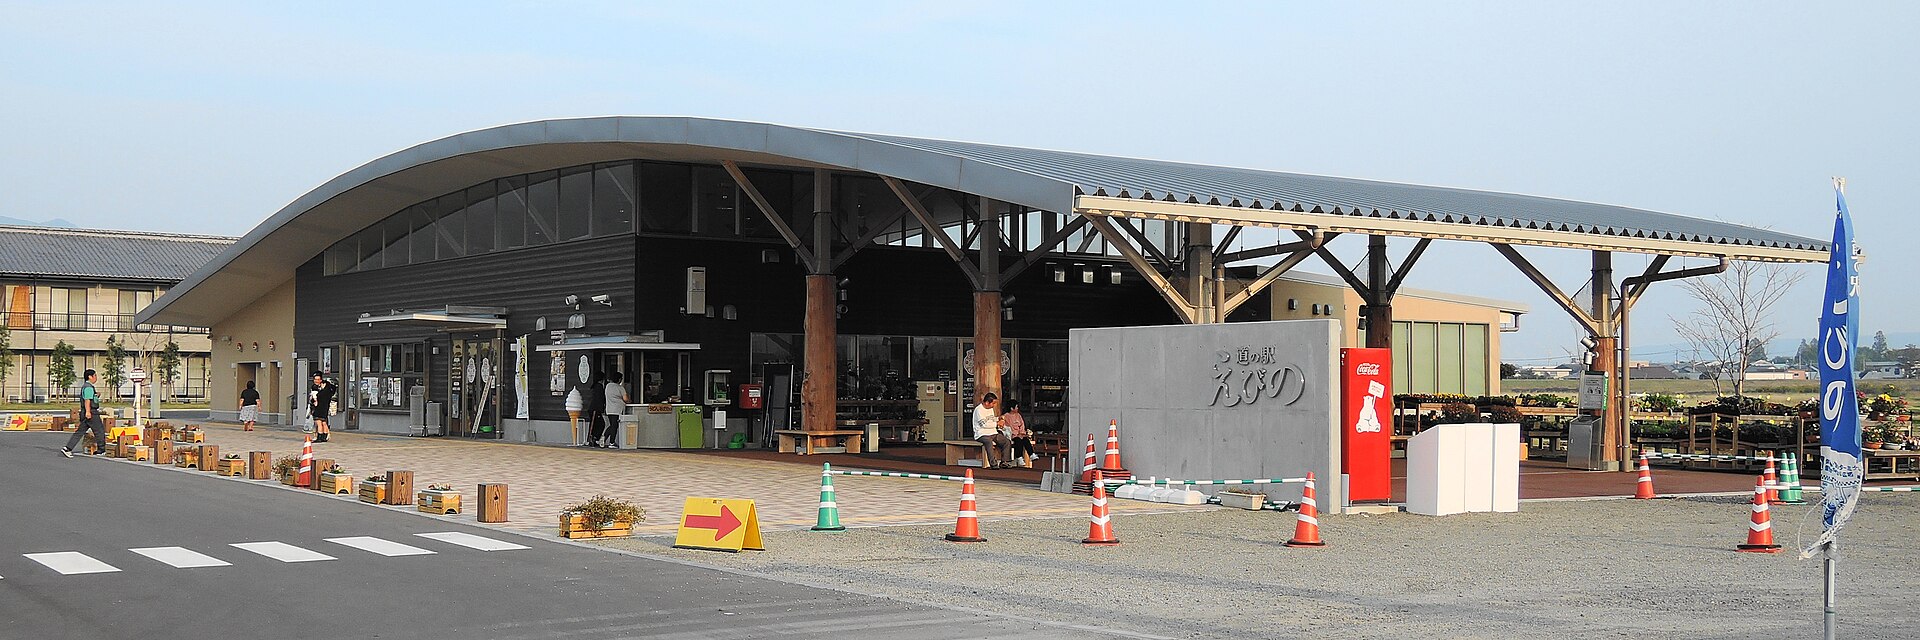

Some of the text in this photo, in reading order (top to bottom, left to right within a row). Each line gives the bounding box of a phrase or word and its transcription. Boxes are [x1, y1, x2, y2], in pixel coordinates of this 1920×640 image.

[1237, 346, 1276, 366] 道の駅
[1208, 351, 1306, 408] えびの
